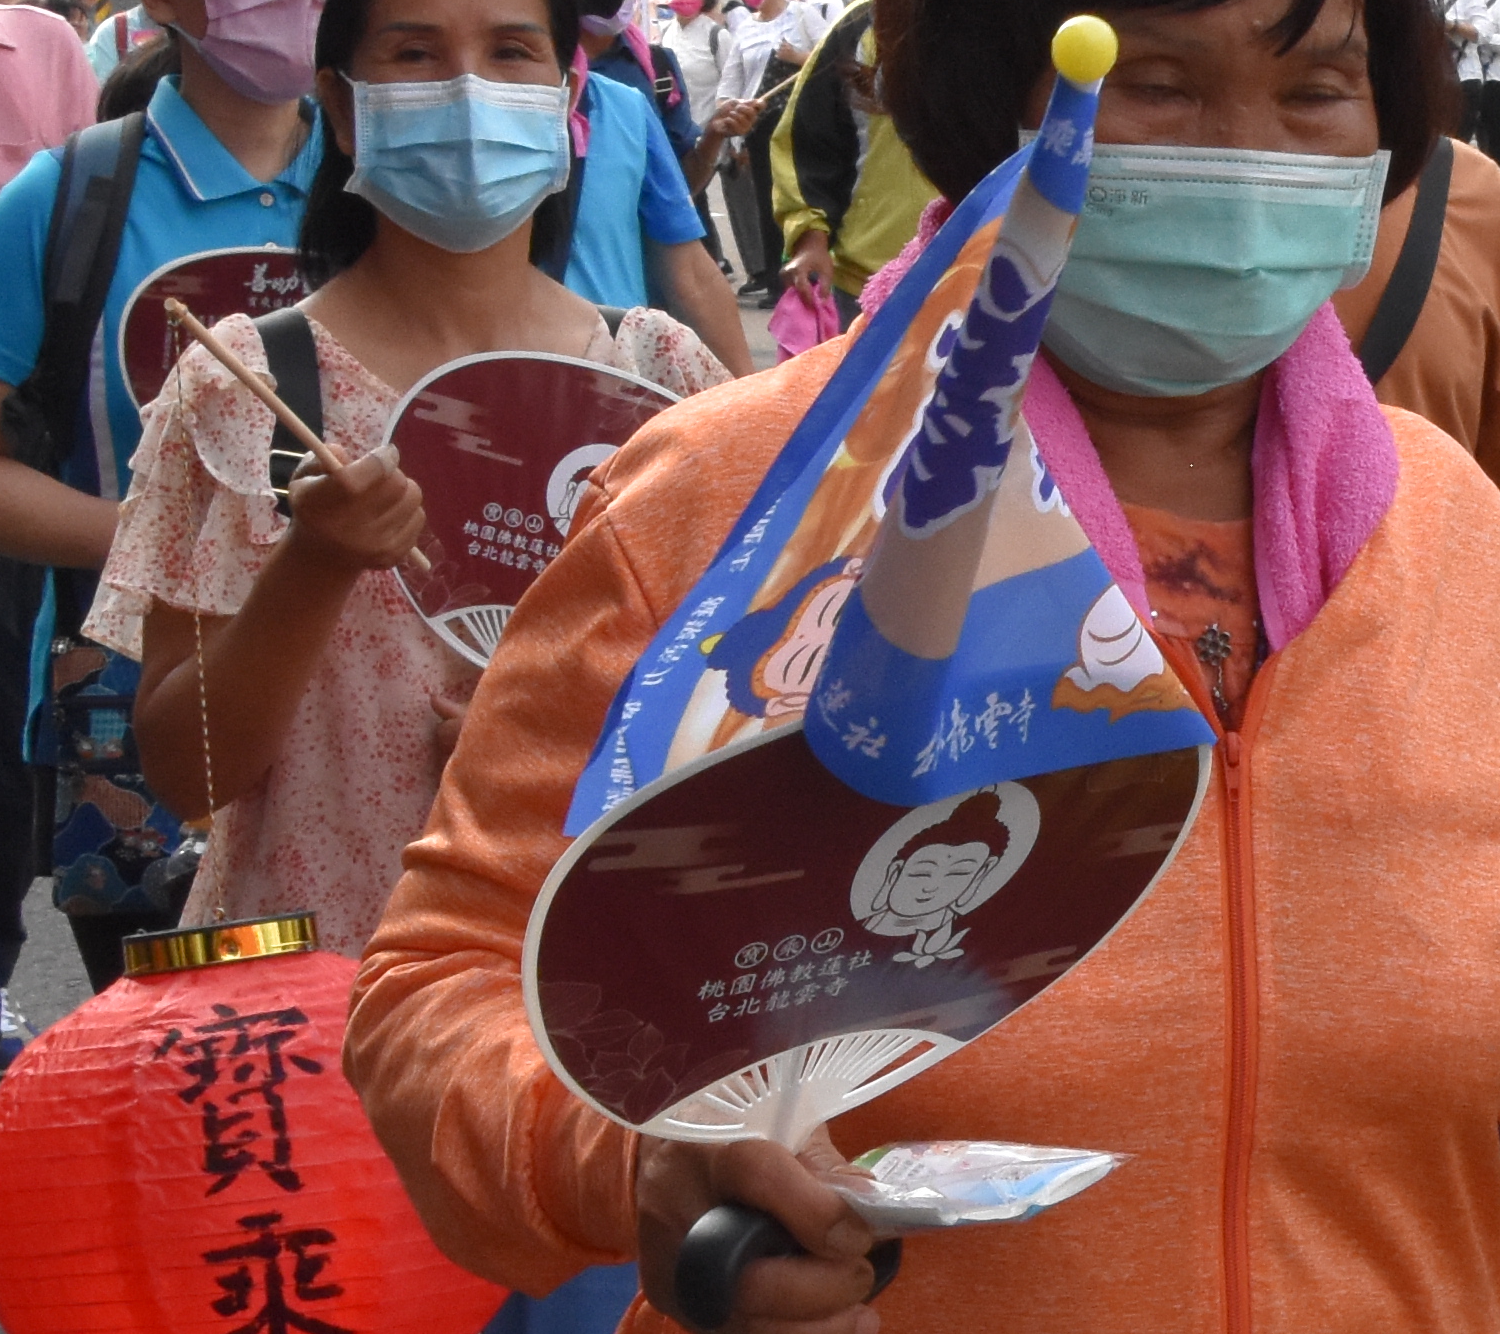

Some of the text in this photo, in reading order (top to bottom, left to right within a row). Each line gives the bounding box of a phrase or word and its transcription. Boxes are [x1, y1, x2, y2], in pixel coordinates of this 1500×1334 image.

[697, 949, 873, 1001] 桃園佛教蓮社
[707, 976, 849, 1023] 台北龍雲寺
